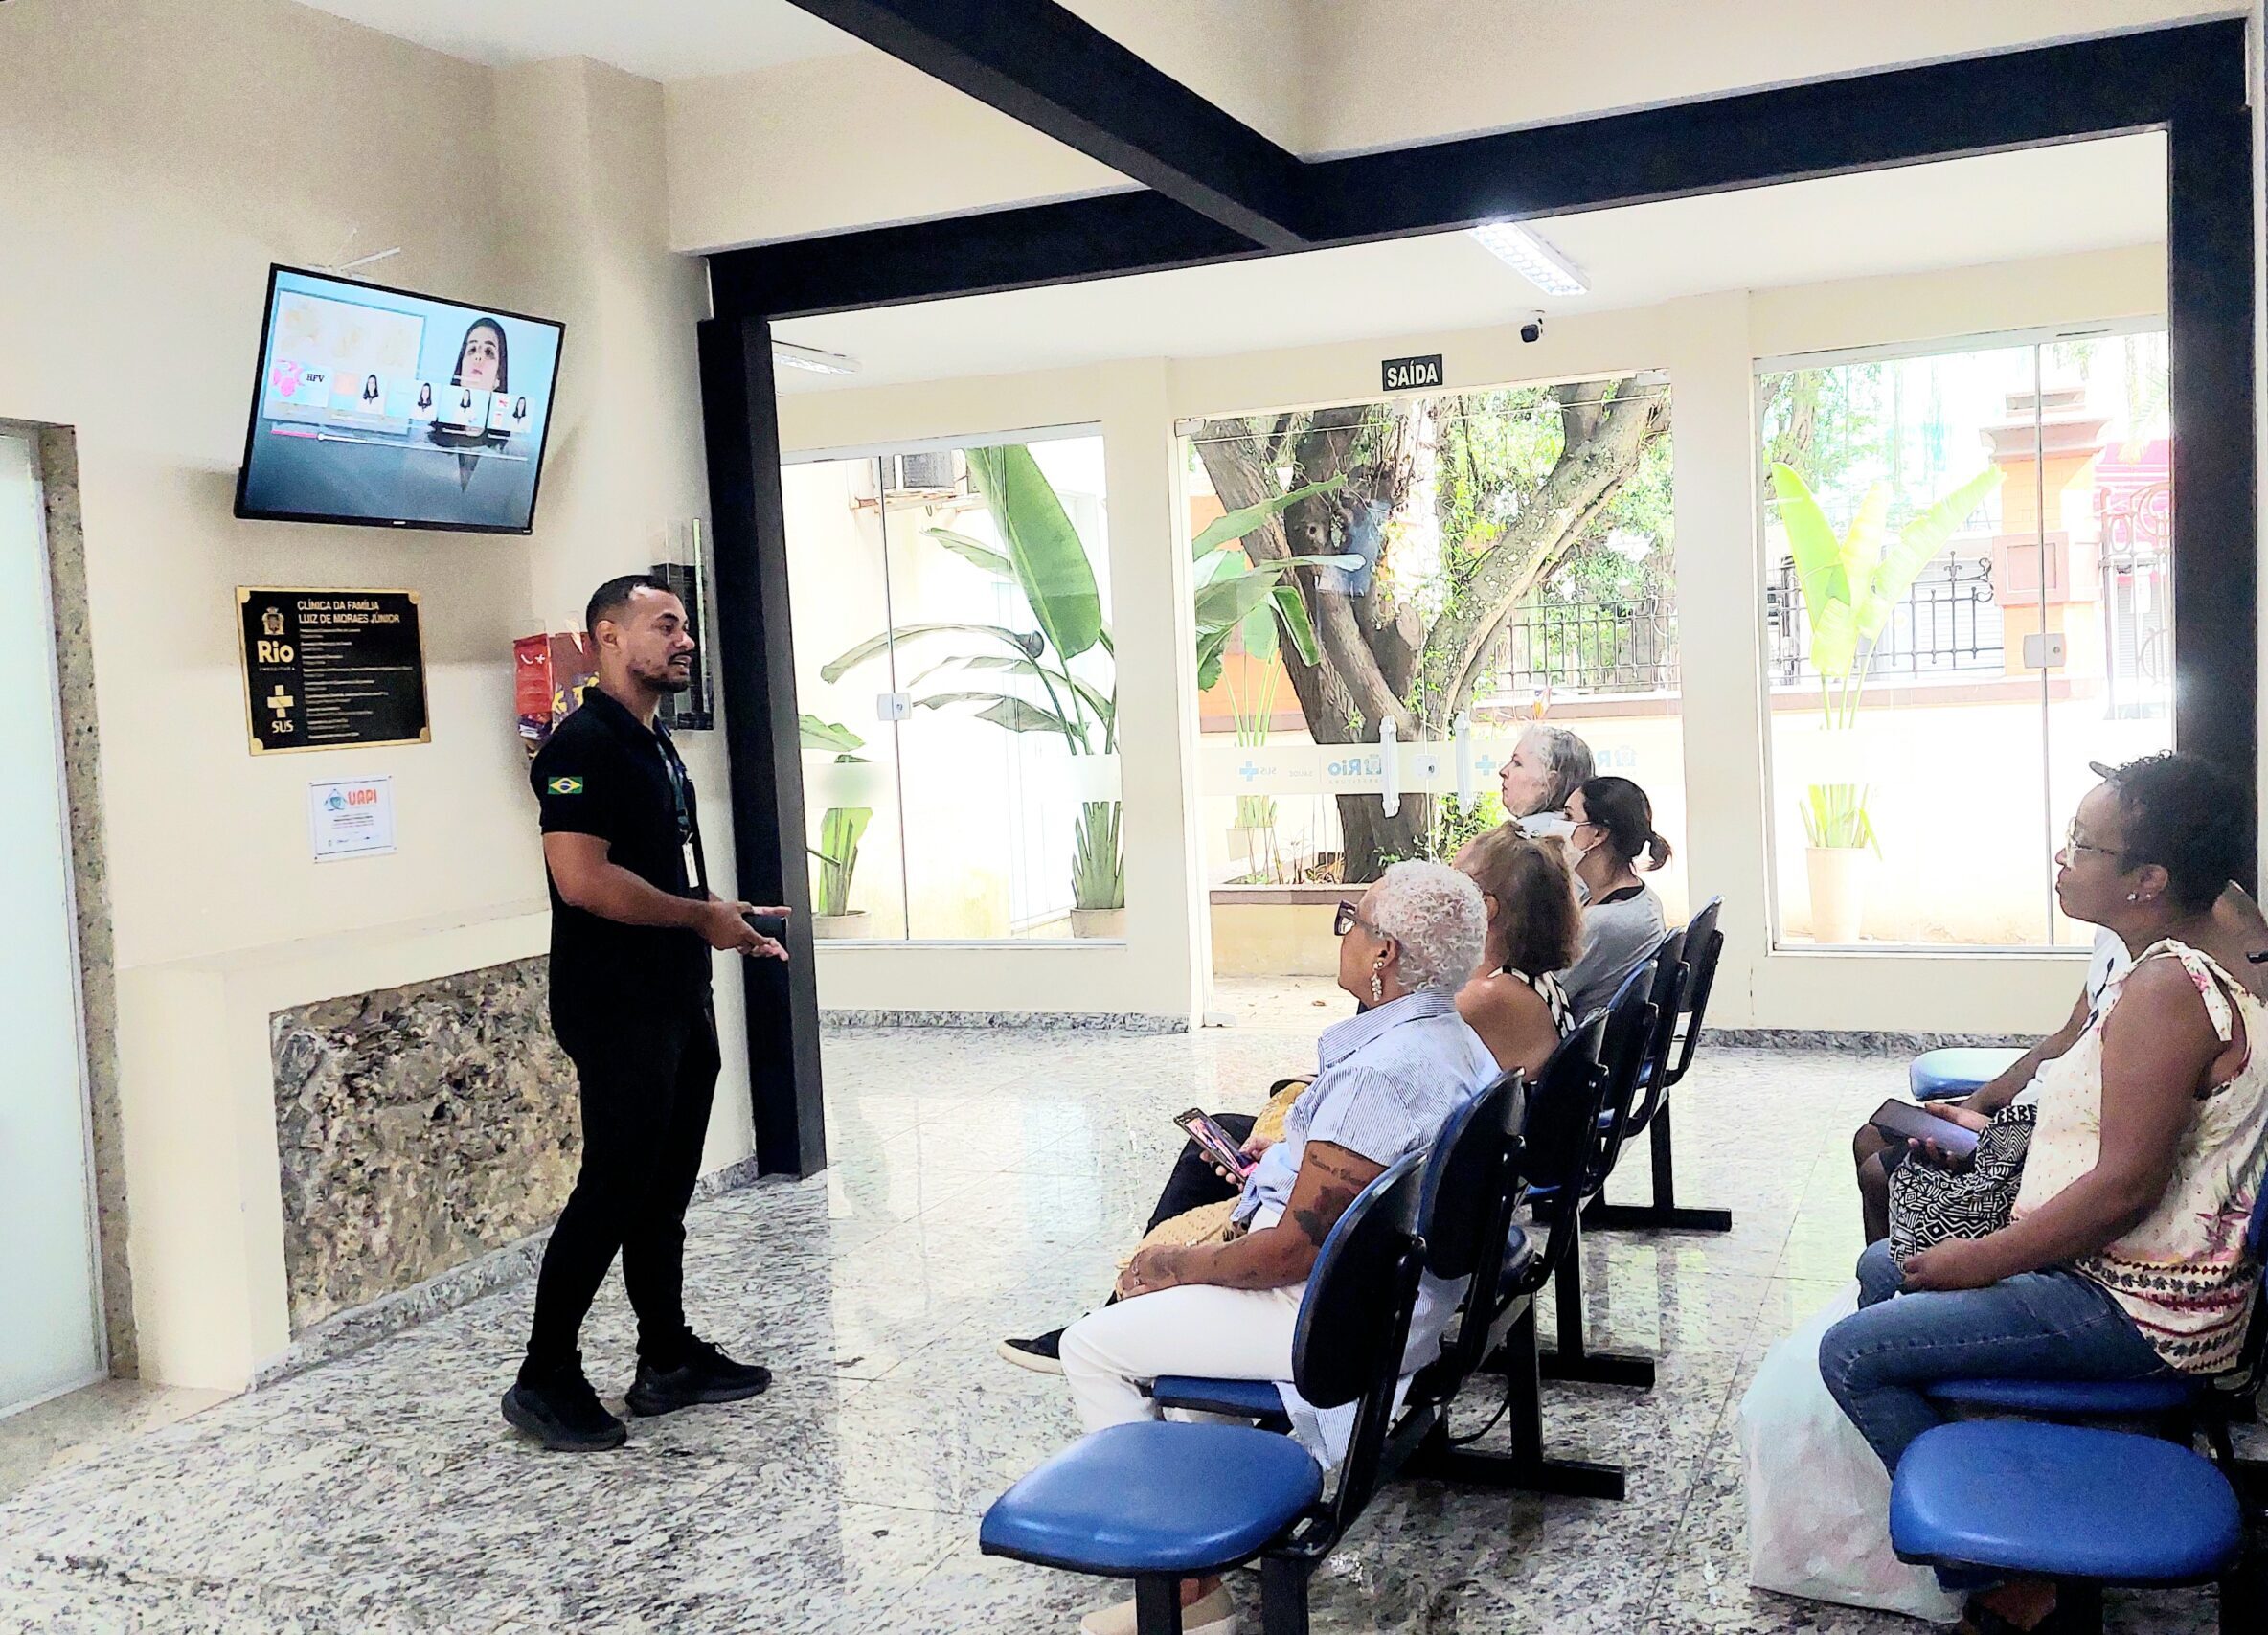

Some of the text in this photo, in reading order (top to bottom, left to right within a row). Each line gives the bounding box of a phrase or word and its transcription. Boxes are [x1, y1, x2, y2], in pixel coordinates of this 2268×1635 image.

[1387, 360, 1439, 388] SAÍDA
[297, 599, 379, 611] CLÍNICA DA FAMÍLIA
[298, 612, 400, 624] LUIZ DE MORAES JÚNIOR
[257, 640, 294, 663] Rio
[271, 719, 294, 734] SUS
